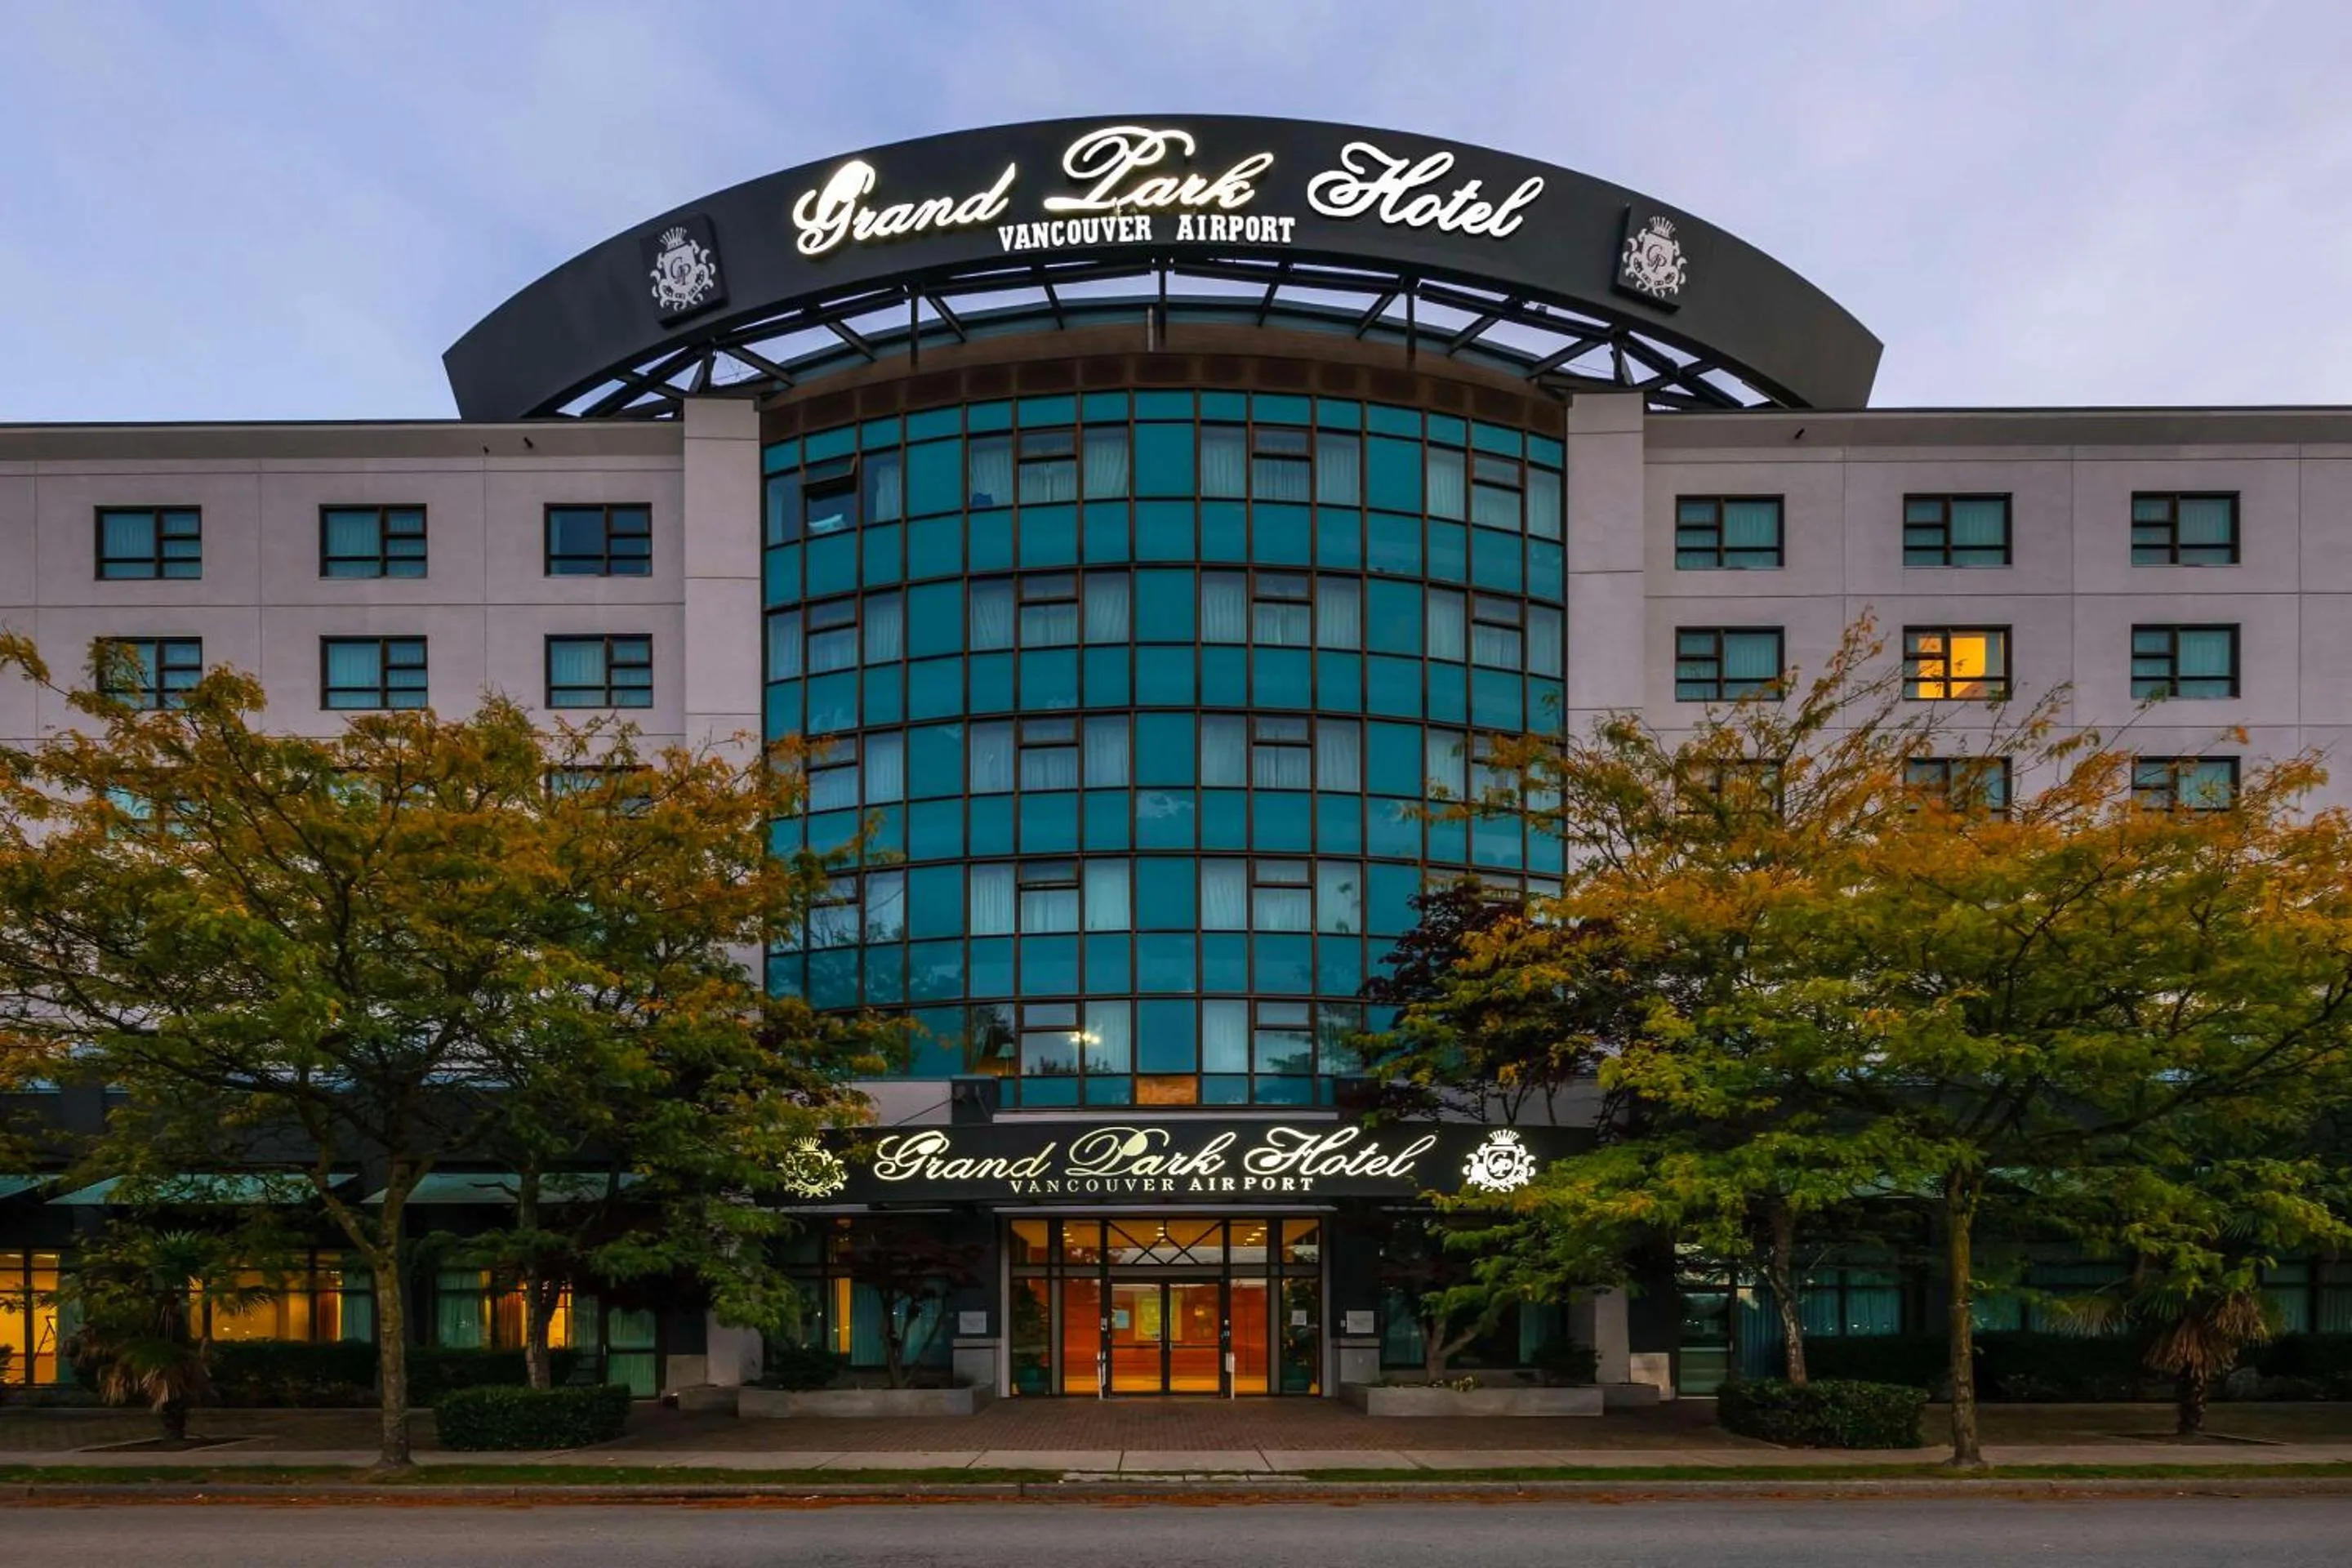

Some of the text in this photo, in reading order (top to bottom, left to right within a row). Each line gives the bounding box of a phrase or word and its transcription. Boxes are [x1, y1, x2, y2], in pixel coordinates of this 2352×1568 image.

[792, 126, 1544, 255] Grand Park Hotel
[998, 214, 1296, 252] VANCOUVER AIRPORT
[873, 1126, 1437, 1181] Grand Park Hotel
[1009, 1177, 1314, 1193] VANCOUVER AIRPORT
